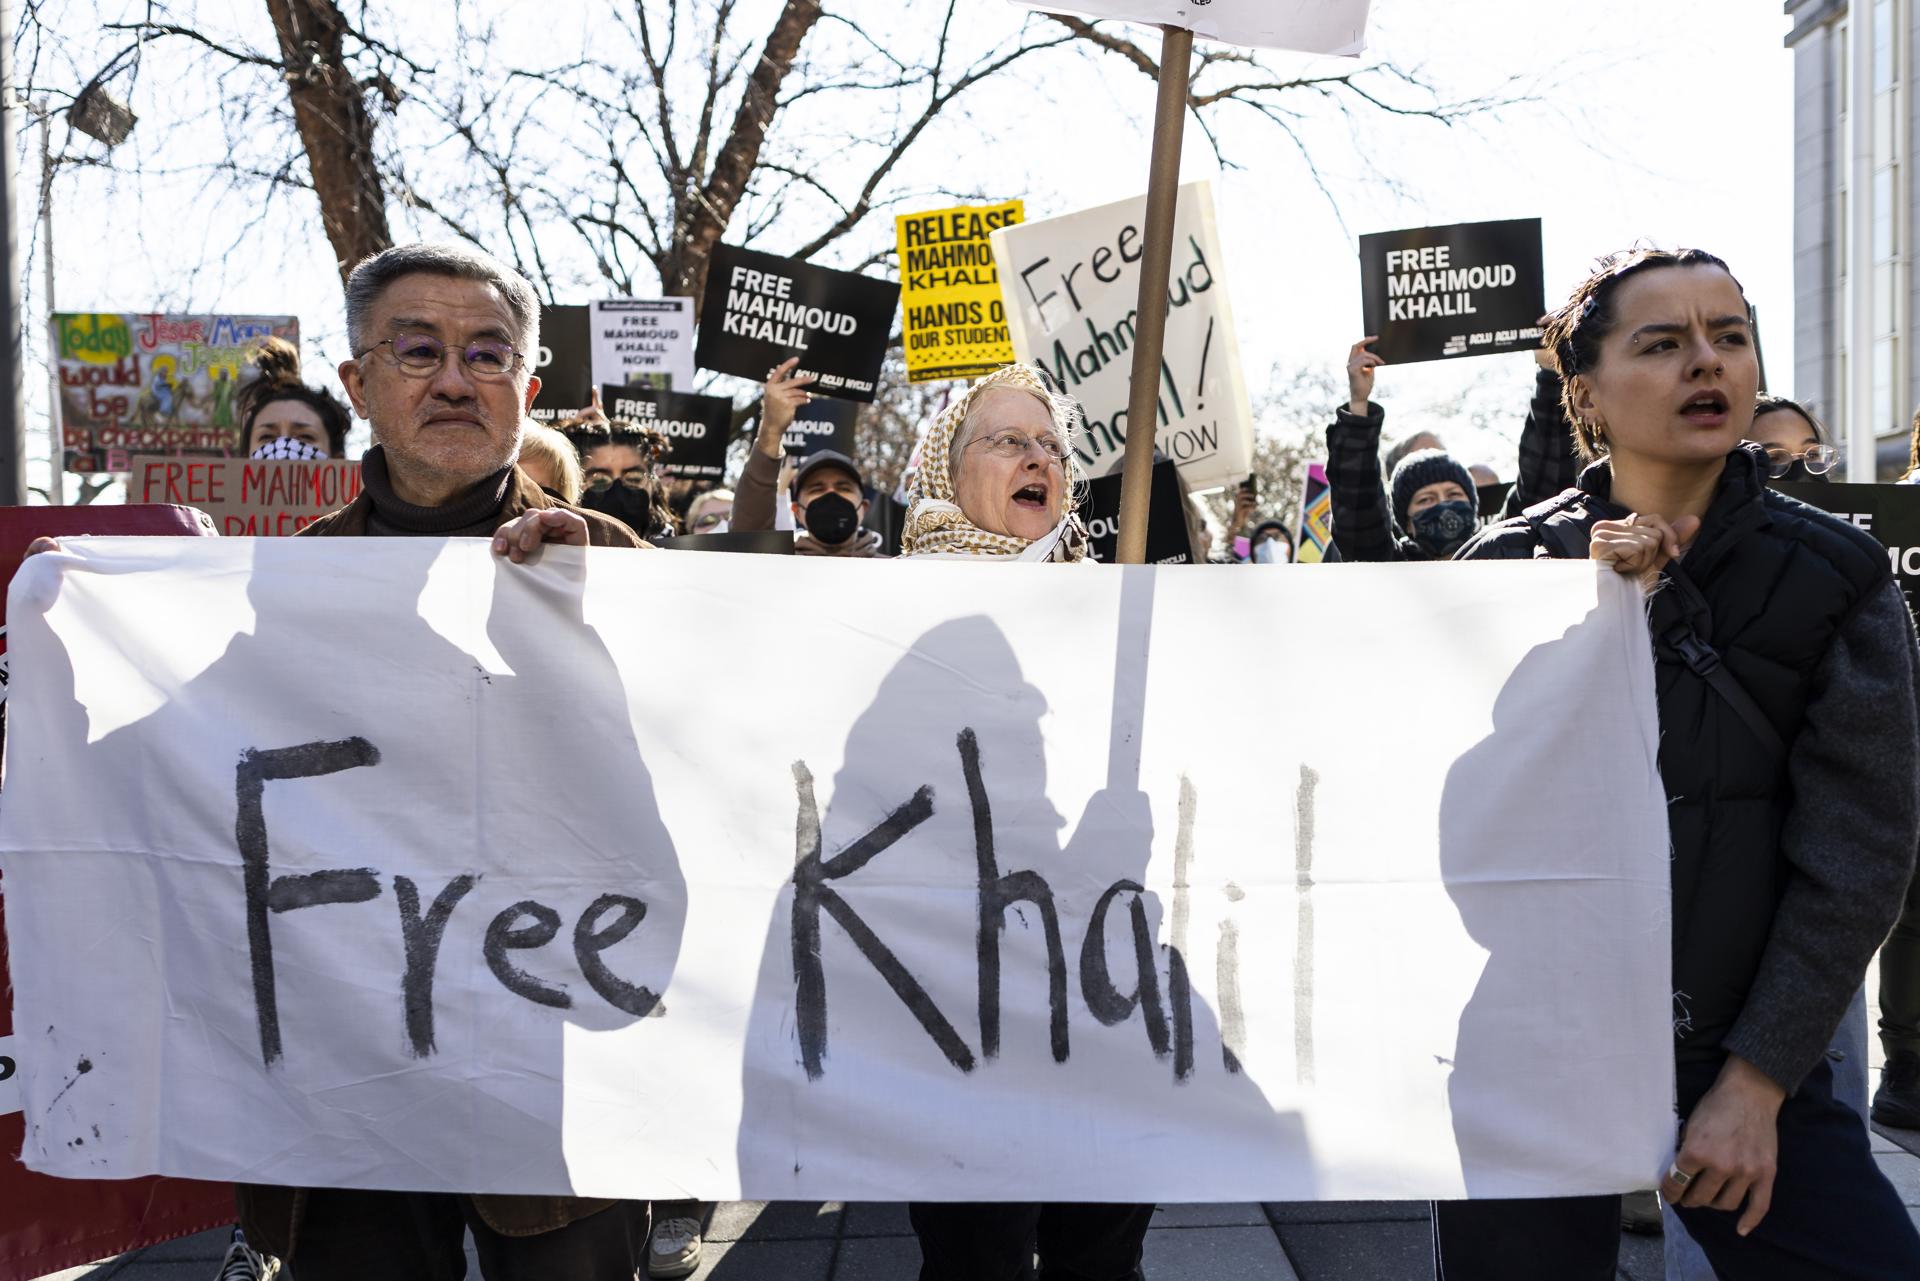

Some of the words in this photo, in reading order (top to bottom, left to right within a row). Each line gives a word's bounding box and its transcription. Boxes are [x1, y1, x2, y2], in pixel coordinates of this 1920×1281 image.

[905, 208, 1017, 248] RELEASE
[907, 243, 995, 273] MAHMO
[1386, 245, 1450, 273] FREE
[730, 265, 793, 299] FREE
[908, 267, 998, 291] KHALI
[1020, 224, 1143, 333] Free
[1387, 264, 1517, 297] MAHMOUD
[622, 316, 658, 326] FREE
[726, 288, 858, 336] MAHMOUD
[908, 301, 983, 331] HANDS
[1035, 234, 1214, 395] Mahmud
[1388, 292, 1477, 321] KHALIL
[51, 313, 130, 359] Today
[140, 314, 204, 352] Jesus
[211, 316, 271, 346] Mary
[603, 330, 679, 340] MAHMOUD
[722, 311, 808, 350] KHALIL
[910, 331, 940, 350] OUR
[944, 325, 1012, 346] STUDENT
[1468, 331, 1493, 345] ACLU
[1494, 329, 1518, 342] ACLU
[615, 344, 668, 353] KHALIL
[622, 356, 661, 365] NOW!
[60, 353, 141, 387] would
[819, 373, 844, 386] ACLU
[91, 388, 128, 419] be
[557, 408, 580, 420] NYC
[615, 398, 657, 419] FREE
[63, 421, 93, 454] by
[99, 417, 236, 449] checkpoints
[786, 419, 835, 436] MOUD
[143, 463, 226, 504] FREE
[240, 463, 362, 508] MAHMOU
[235, 736, 668, 1072] Free
[790, 726, 1320, 1086] Khalil
